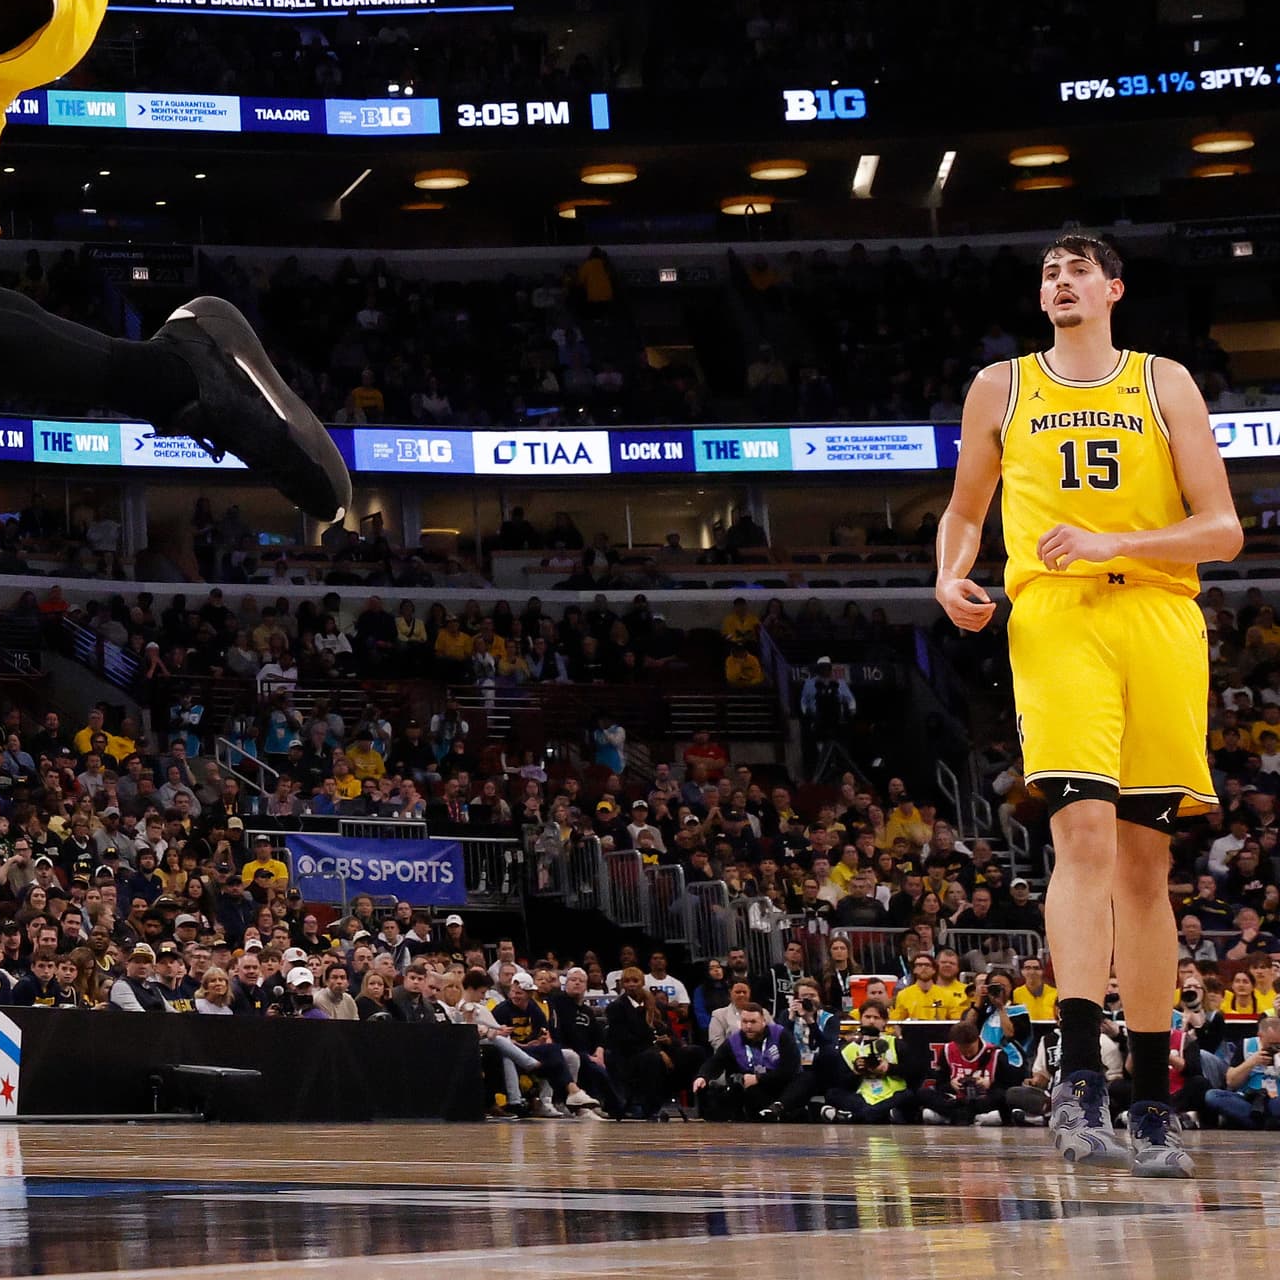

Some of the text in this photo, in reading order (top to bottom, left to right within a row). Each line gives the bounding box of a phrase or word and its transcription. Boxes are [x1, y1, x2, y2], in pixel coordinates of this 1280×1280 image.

[1061, 65, 1271, 102] FG% 39.1% 3PT%
[457, 101, 570, 127] 3:05 PM
[783, 89, 867, 120] B1G
[1030, 410, 1144, 436] MICHIGAN
[5, 431, 23, 449] IN
[40, 431, 72, 452] THE
[75, 434, 109, 452] WIN
[396, 438, 452, 463] B1G
[524, 441, 592, 465] TIAA
[1058, 439, 1121, 491] 15
[1108, 572, 1125, 585] M
[317, 859, 454, 883] CBS SPORTS
